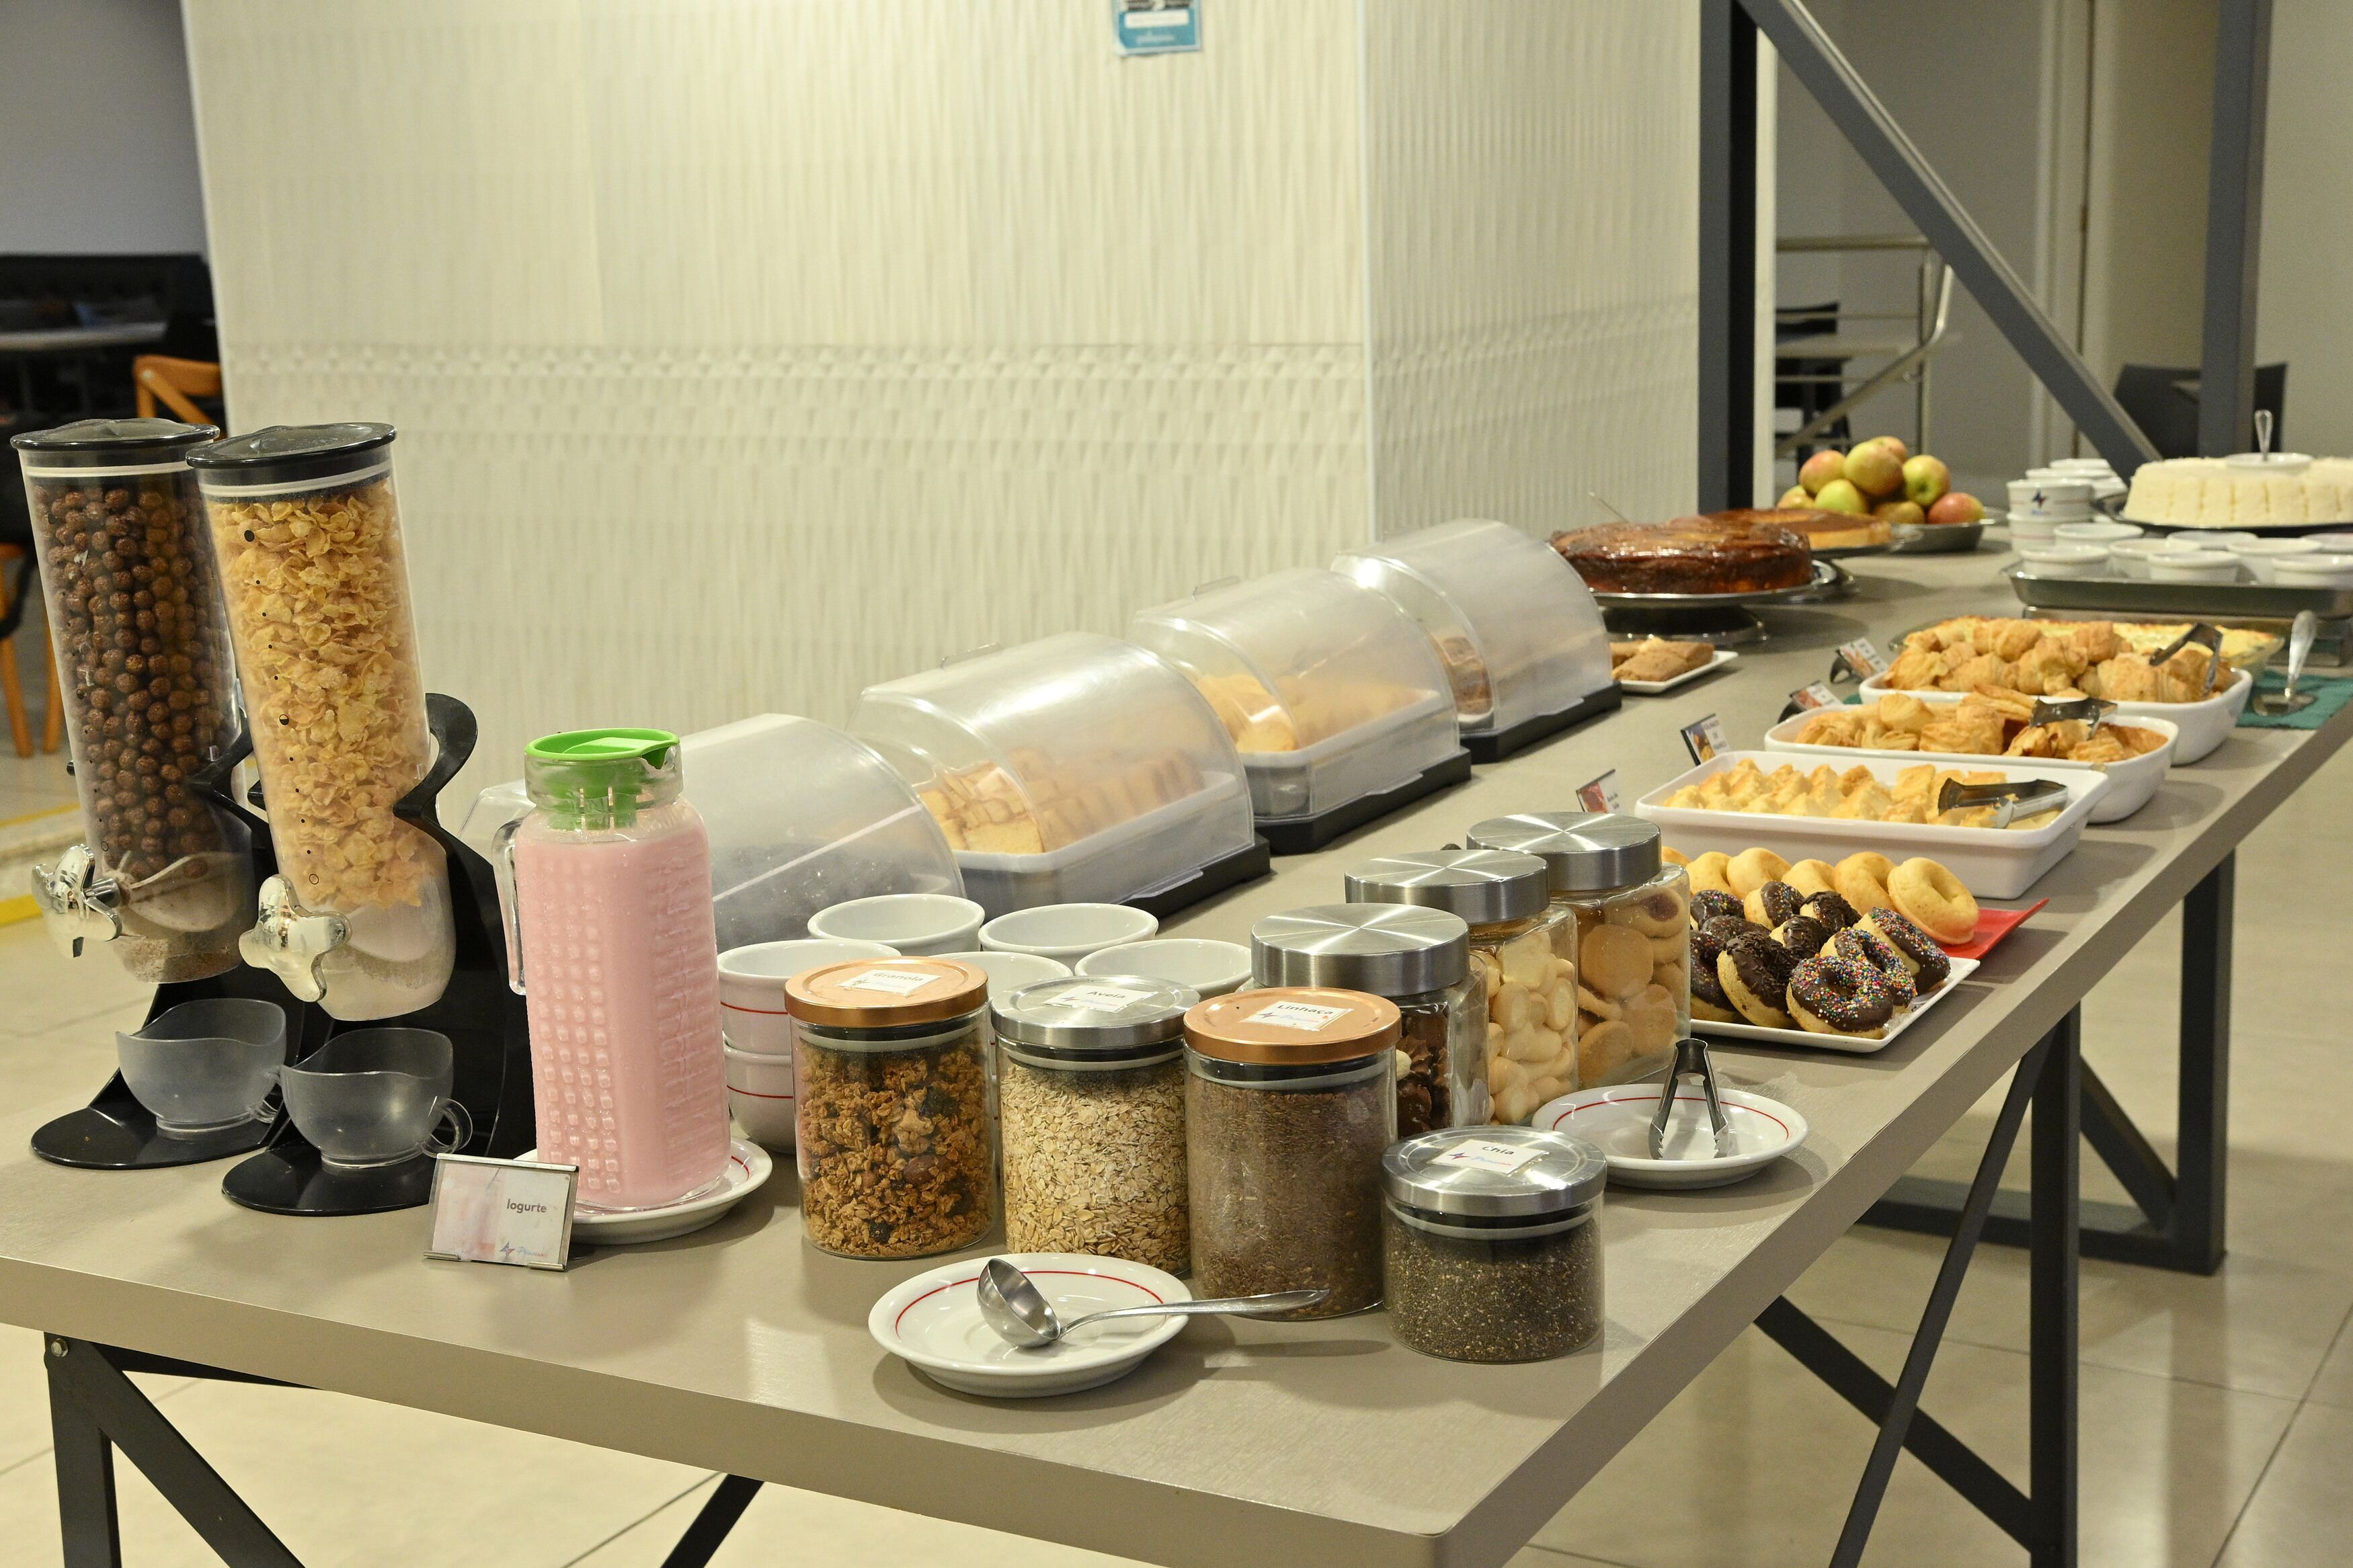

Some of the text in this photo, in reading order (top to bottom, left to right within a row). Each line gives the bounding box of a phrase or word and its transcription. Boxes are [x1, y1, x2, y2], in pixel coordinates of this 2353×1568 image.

[873, 972, 924, 982] Granola
[1086, 991, 1126, 999] Aveia
[1277, 1004, 1334, 1015] Linhaça
[1482, 1145, 1515, 1155] Chia
[506, 1199, 547, 1213] Iogurte
